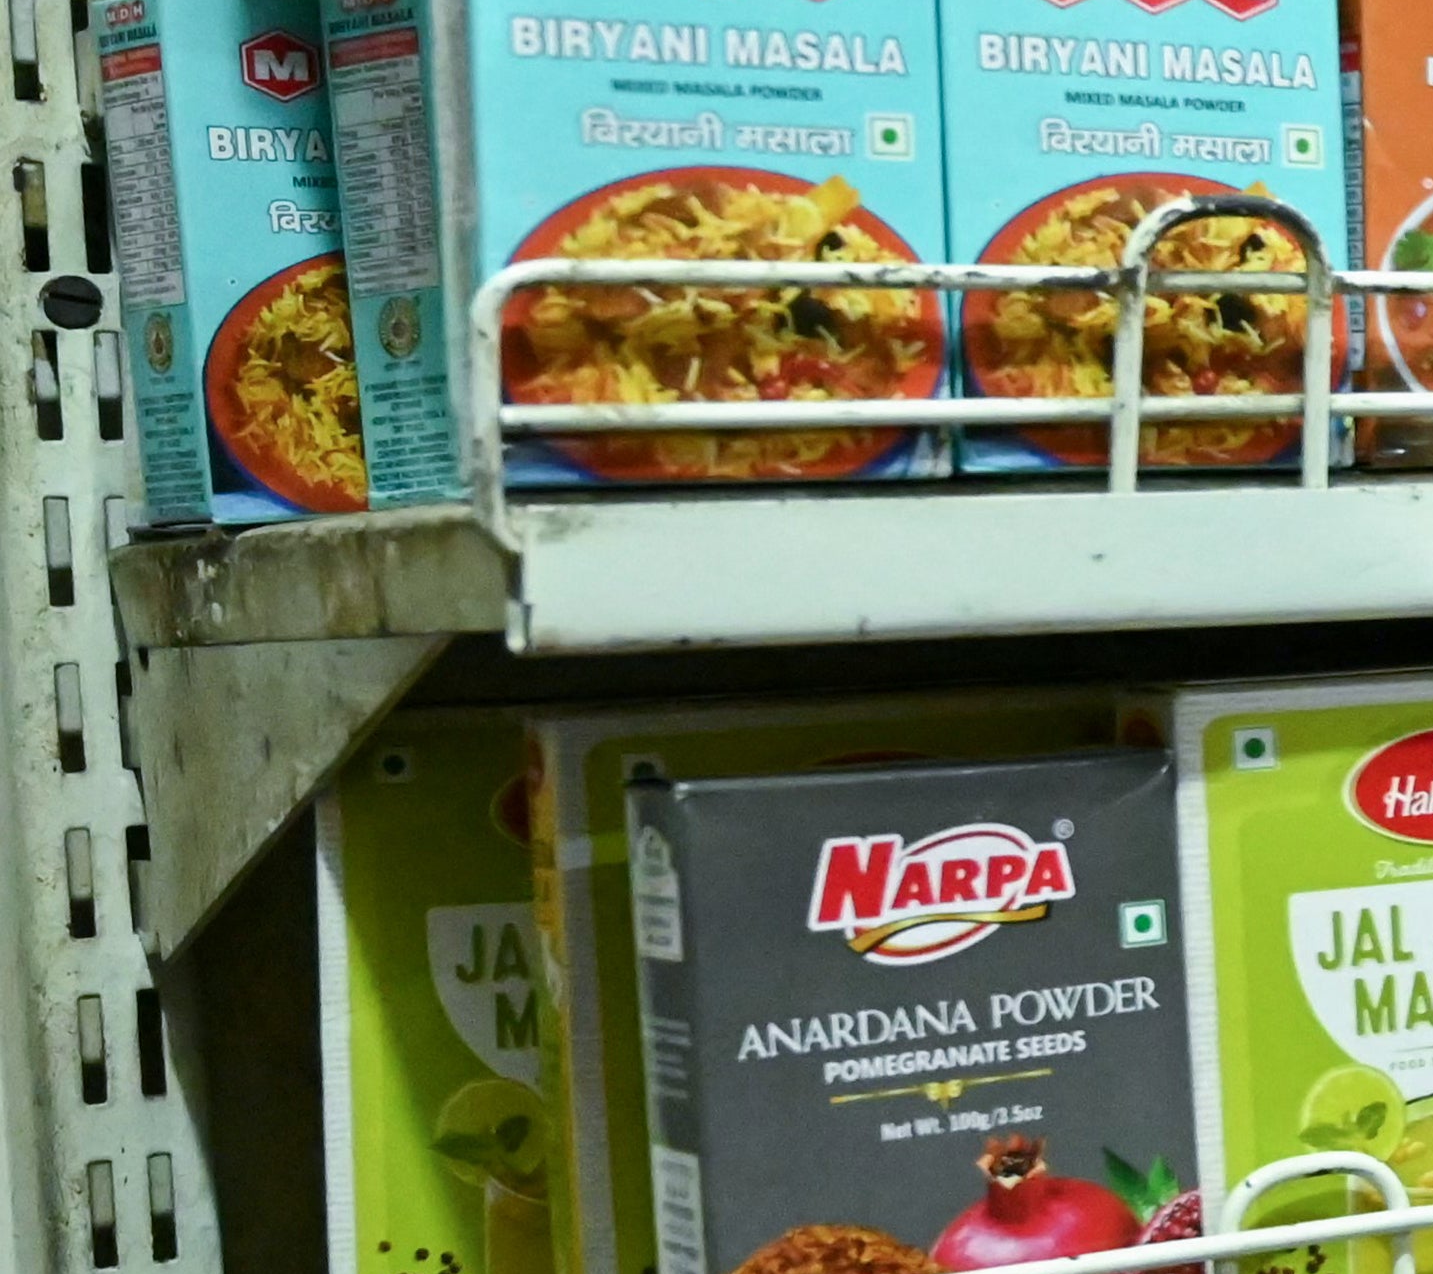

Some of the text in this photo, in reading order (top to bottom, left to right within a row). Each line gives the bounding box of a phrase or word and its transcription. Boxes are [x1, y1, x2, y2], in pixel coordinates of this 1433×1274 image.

[510, 16, 908, 75] BIRYANI MASALA
[978, 33, 1318, 91] BIRYANI MASALA
[816, 838, 1071, 924] NARPA
[1316, 904, 1414, 973] JAL
[738, 975, 1160, 1062] ANARDANA POWDER
[823, 1030, 1087, 1084] POMEGRANATE SEEDS
